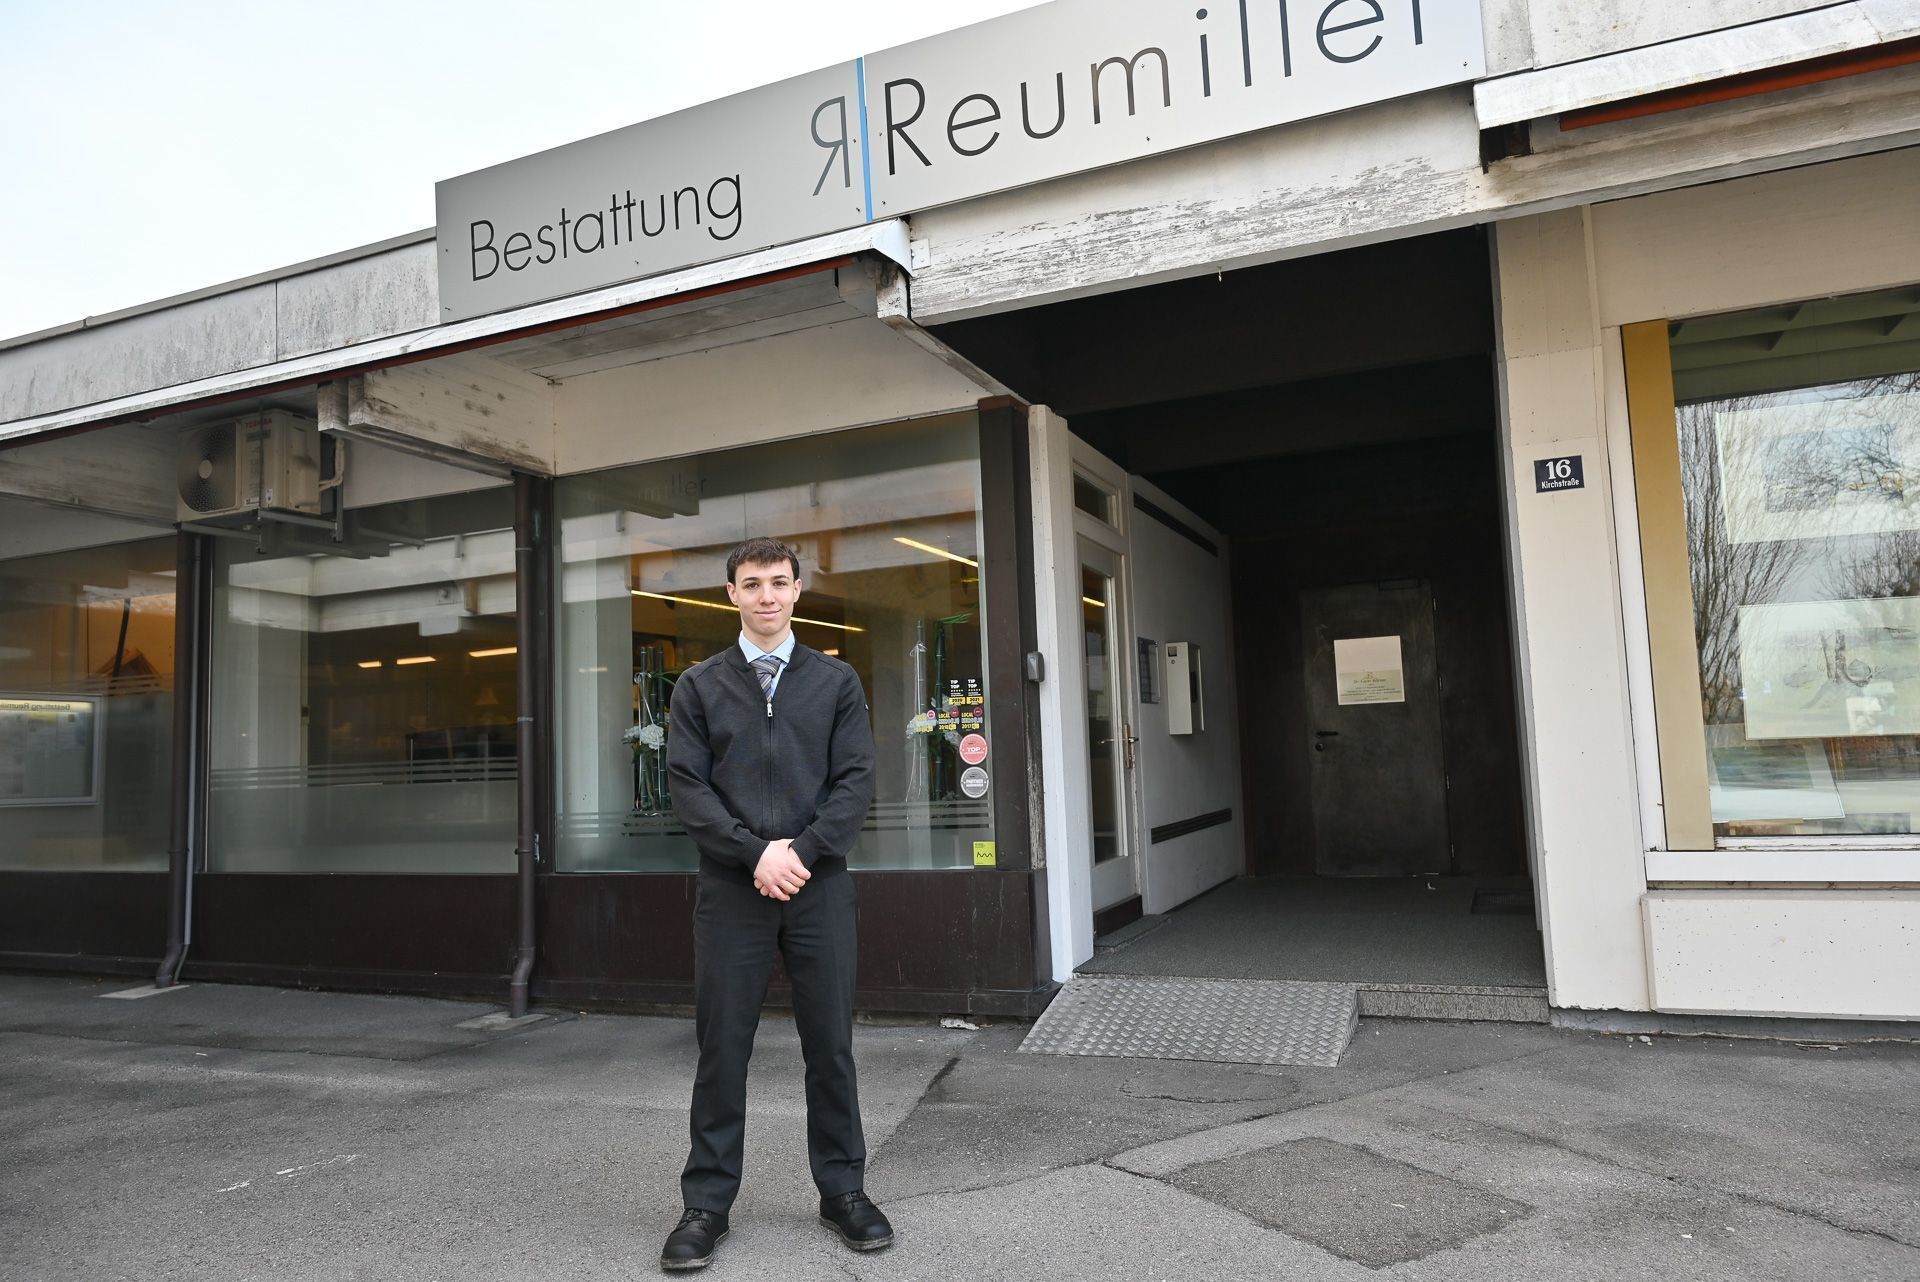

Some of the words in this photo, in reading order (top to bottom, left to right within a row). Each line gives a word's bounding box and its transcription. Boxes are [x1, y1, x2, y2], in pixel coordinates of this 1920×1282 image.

[470, 174, 742, 282] Bestattung
[245, 418, 273, 429] TOSHBA
[1546, 459, 1572, 480] 16
[1541, 478, 1580, 489] Kirchstraße
